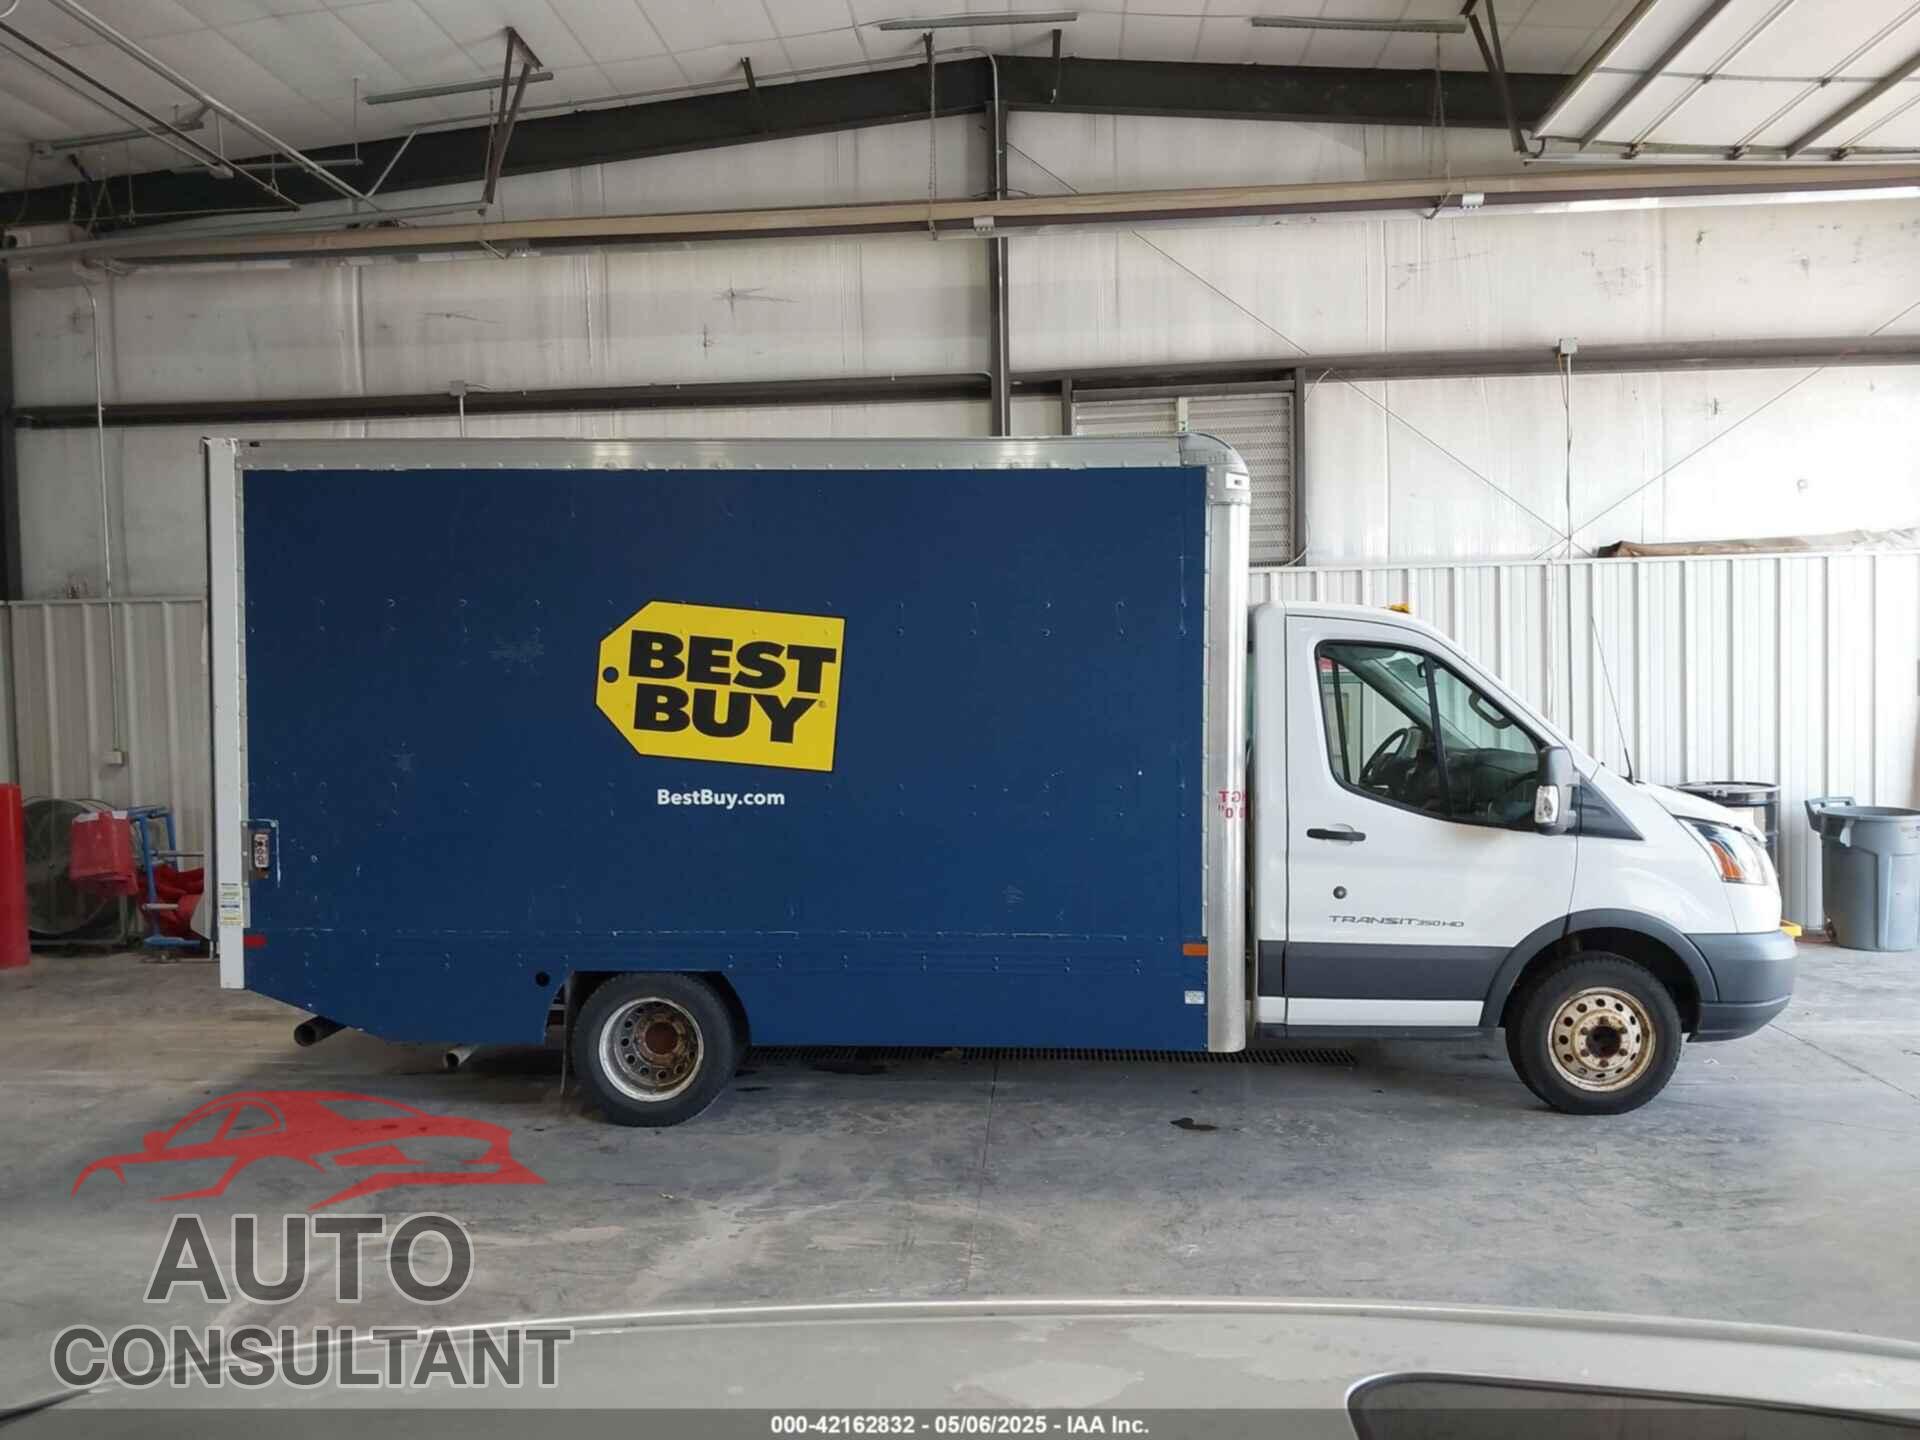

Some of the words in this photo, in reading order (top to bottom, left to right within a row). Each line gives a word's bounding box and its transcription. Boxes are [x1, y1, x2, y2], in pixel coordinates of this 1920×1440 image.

[628, 630, 837, 694] BEST
[633, 683, 818, 744] BUY
[657, 789, 785, 810] BestBuy.com
[1328, 914, 1417, 926] TRANSIT
